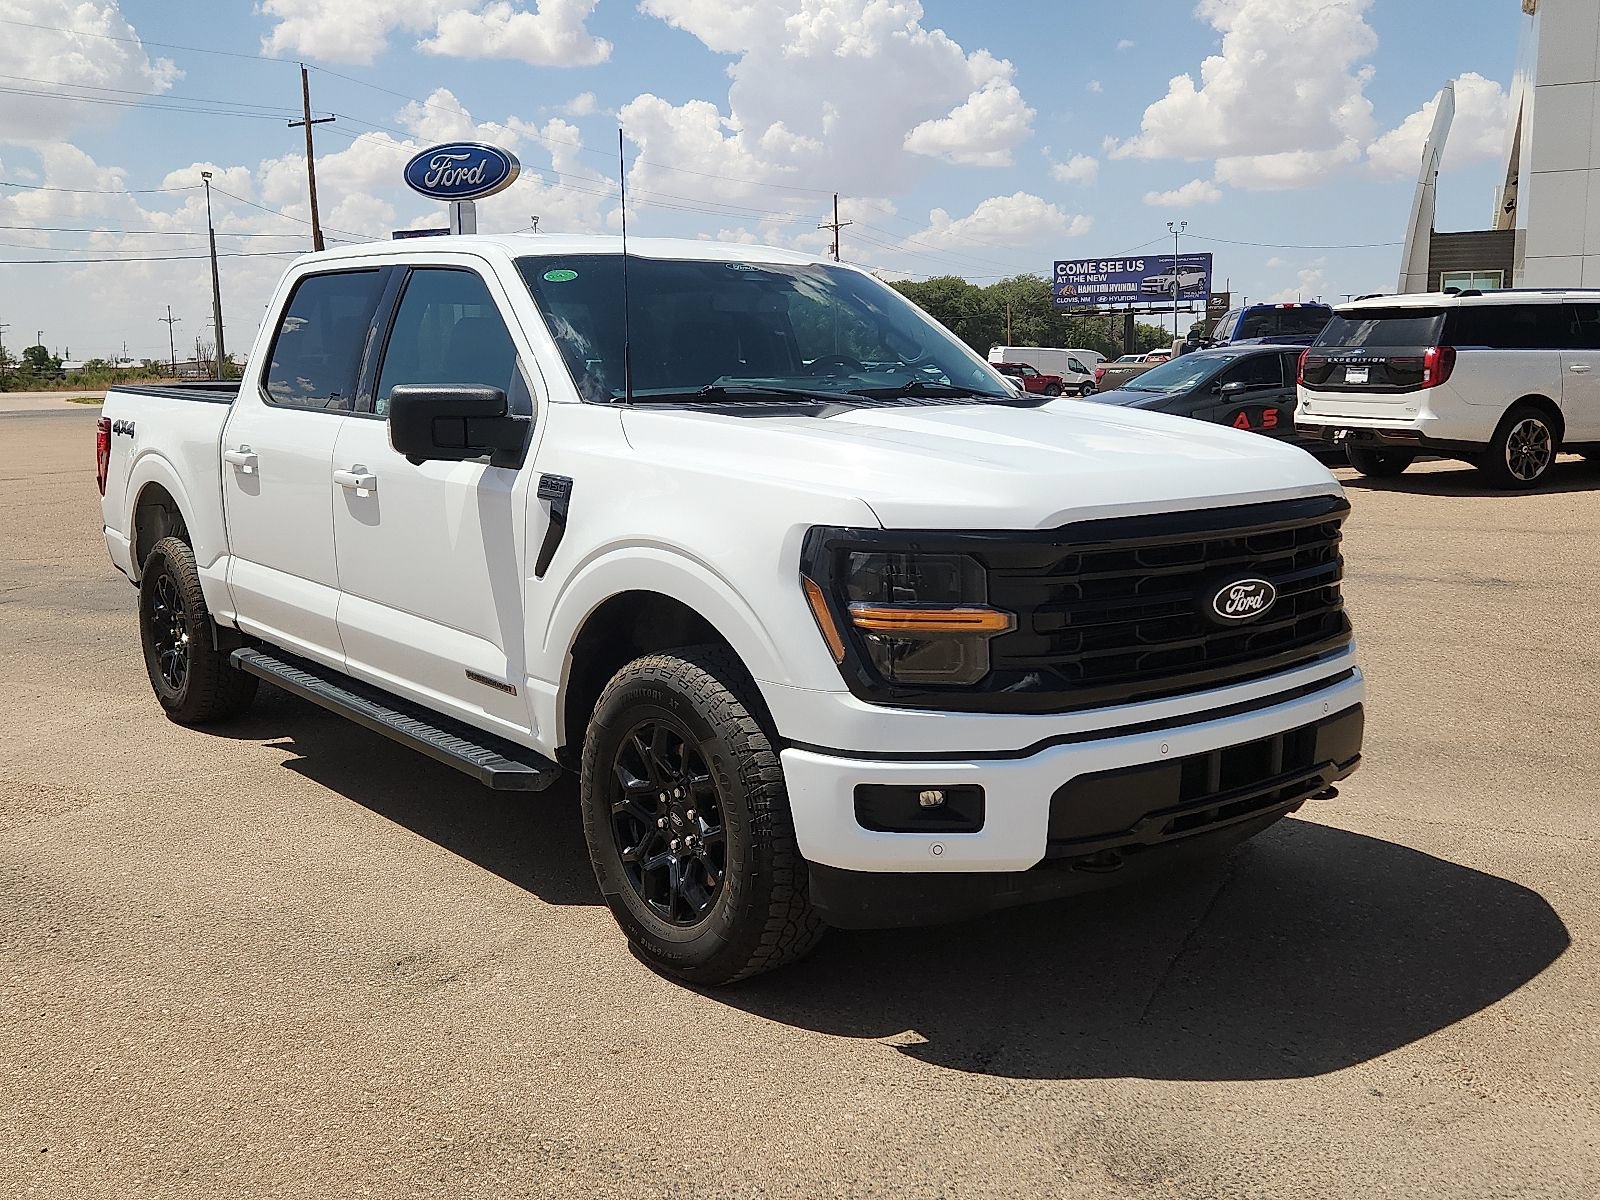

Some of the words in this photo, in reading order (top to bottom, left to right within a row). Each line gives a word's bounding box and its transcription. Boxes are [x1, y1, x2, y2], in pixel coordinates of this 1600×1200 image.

[424, 152, 487, 188] Ford
[1056, 262, 1097, 275] COME
[1099, 260, 1124, 273] SEE
[1126, 259, 1145, 272] US
[1056, 275, 1067, 284] AT
[1069, 274, 1085, 283] THE
[1086, 273, 1108, 282] NEW
[1077, 283, 1109, 294] HAMILTON
[1109, 282, 1138, 293] HYUNDAI
[1056, 296, 1079, 304] CLOVIS,
[1225, 584, 1265, 613] Ford
